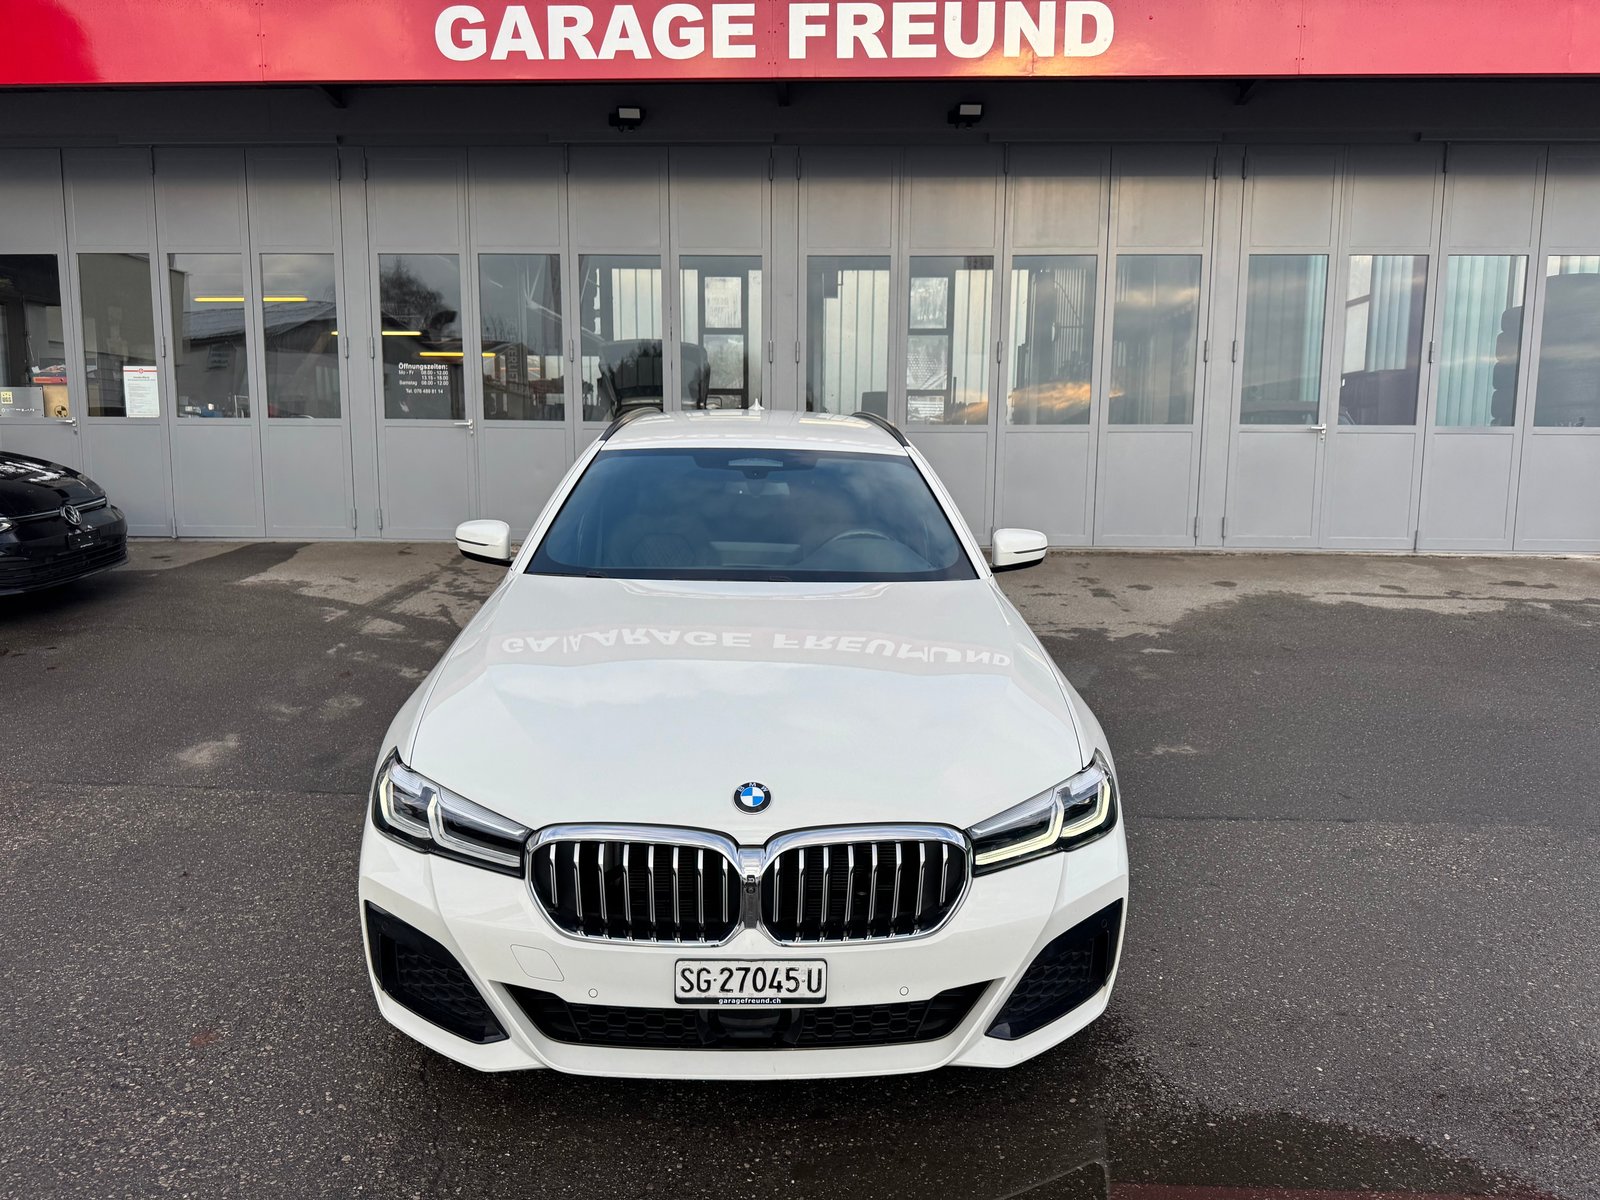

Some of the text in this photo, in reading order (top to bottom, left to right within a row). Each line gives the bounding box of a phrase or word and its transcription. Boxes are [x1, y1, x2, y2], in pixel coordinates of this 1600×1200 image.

[435, 0, 1115, 62] GARAGE FREUND
[398, 361, 449, 370] Öffnungszeiten:
[737, 781, 769, 793] BMW
[718, 997, 782, 1006] garagefreund.ch
